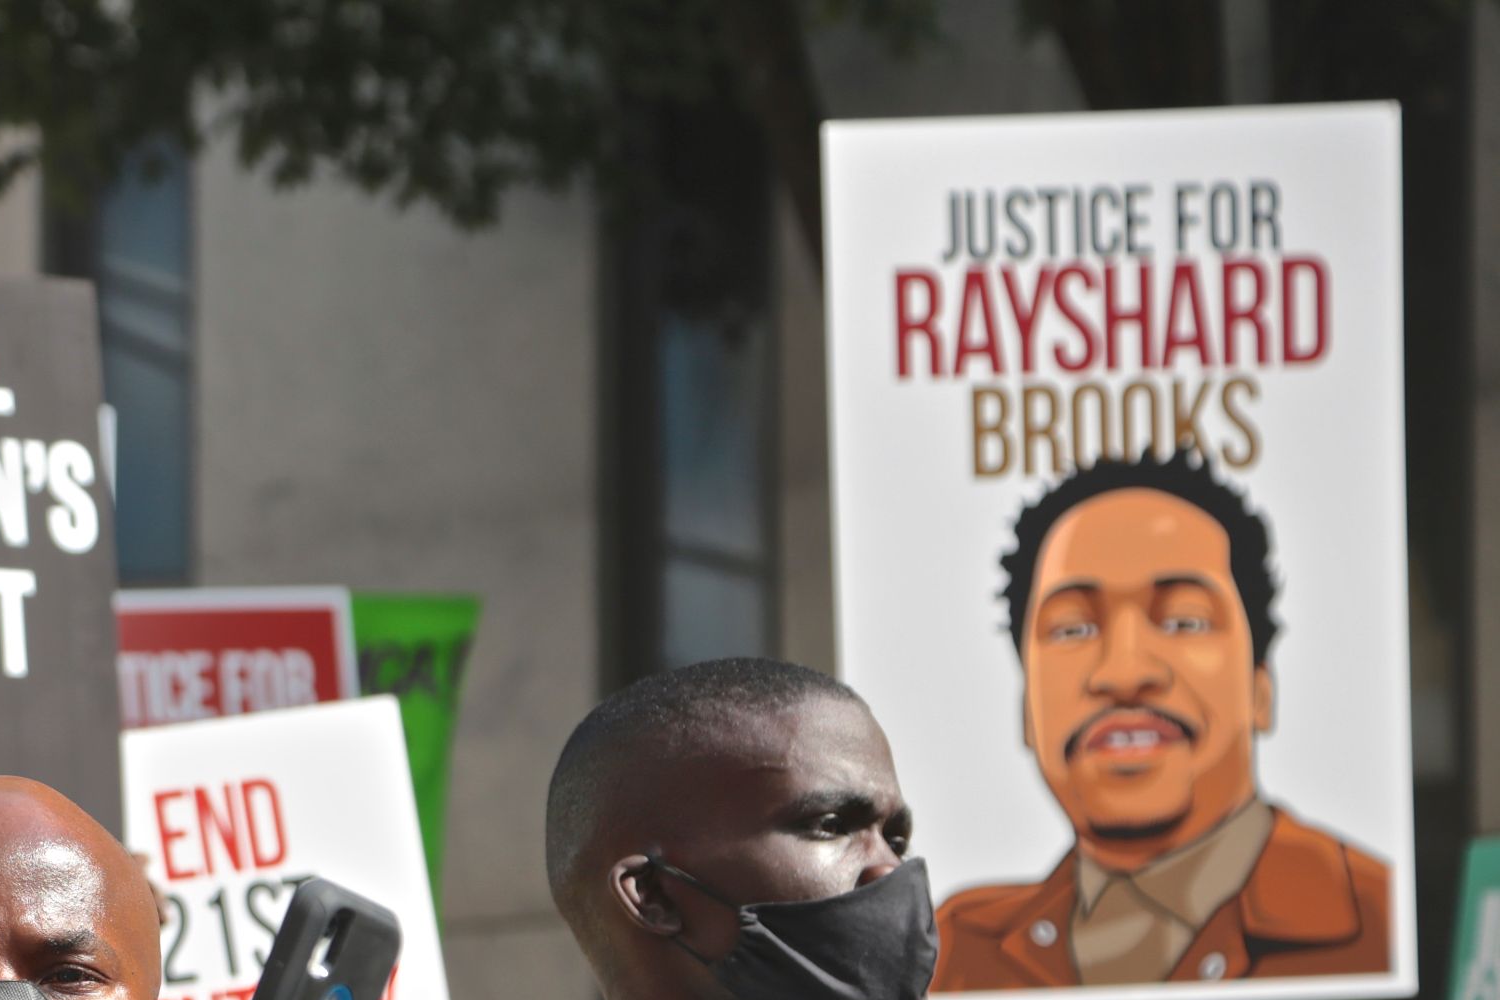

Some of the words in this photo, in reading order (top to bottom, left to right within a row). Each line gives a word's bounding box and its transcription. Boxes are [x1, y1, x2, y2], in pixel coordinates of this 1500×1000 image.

[942, 182, 1153, 264] JUSTICE
[1174, 178, 1283, 252] FOR
[894, 252, 1333, 380] RAYSHARD
[971, 374, 1264, 482] BROOKS
[117, 648, 218, 725] TICE
[219, 648, 318, 716] FOR
[153, 777, 288, 882] END
[162, 874, 308, 987] 21S
